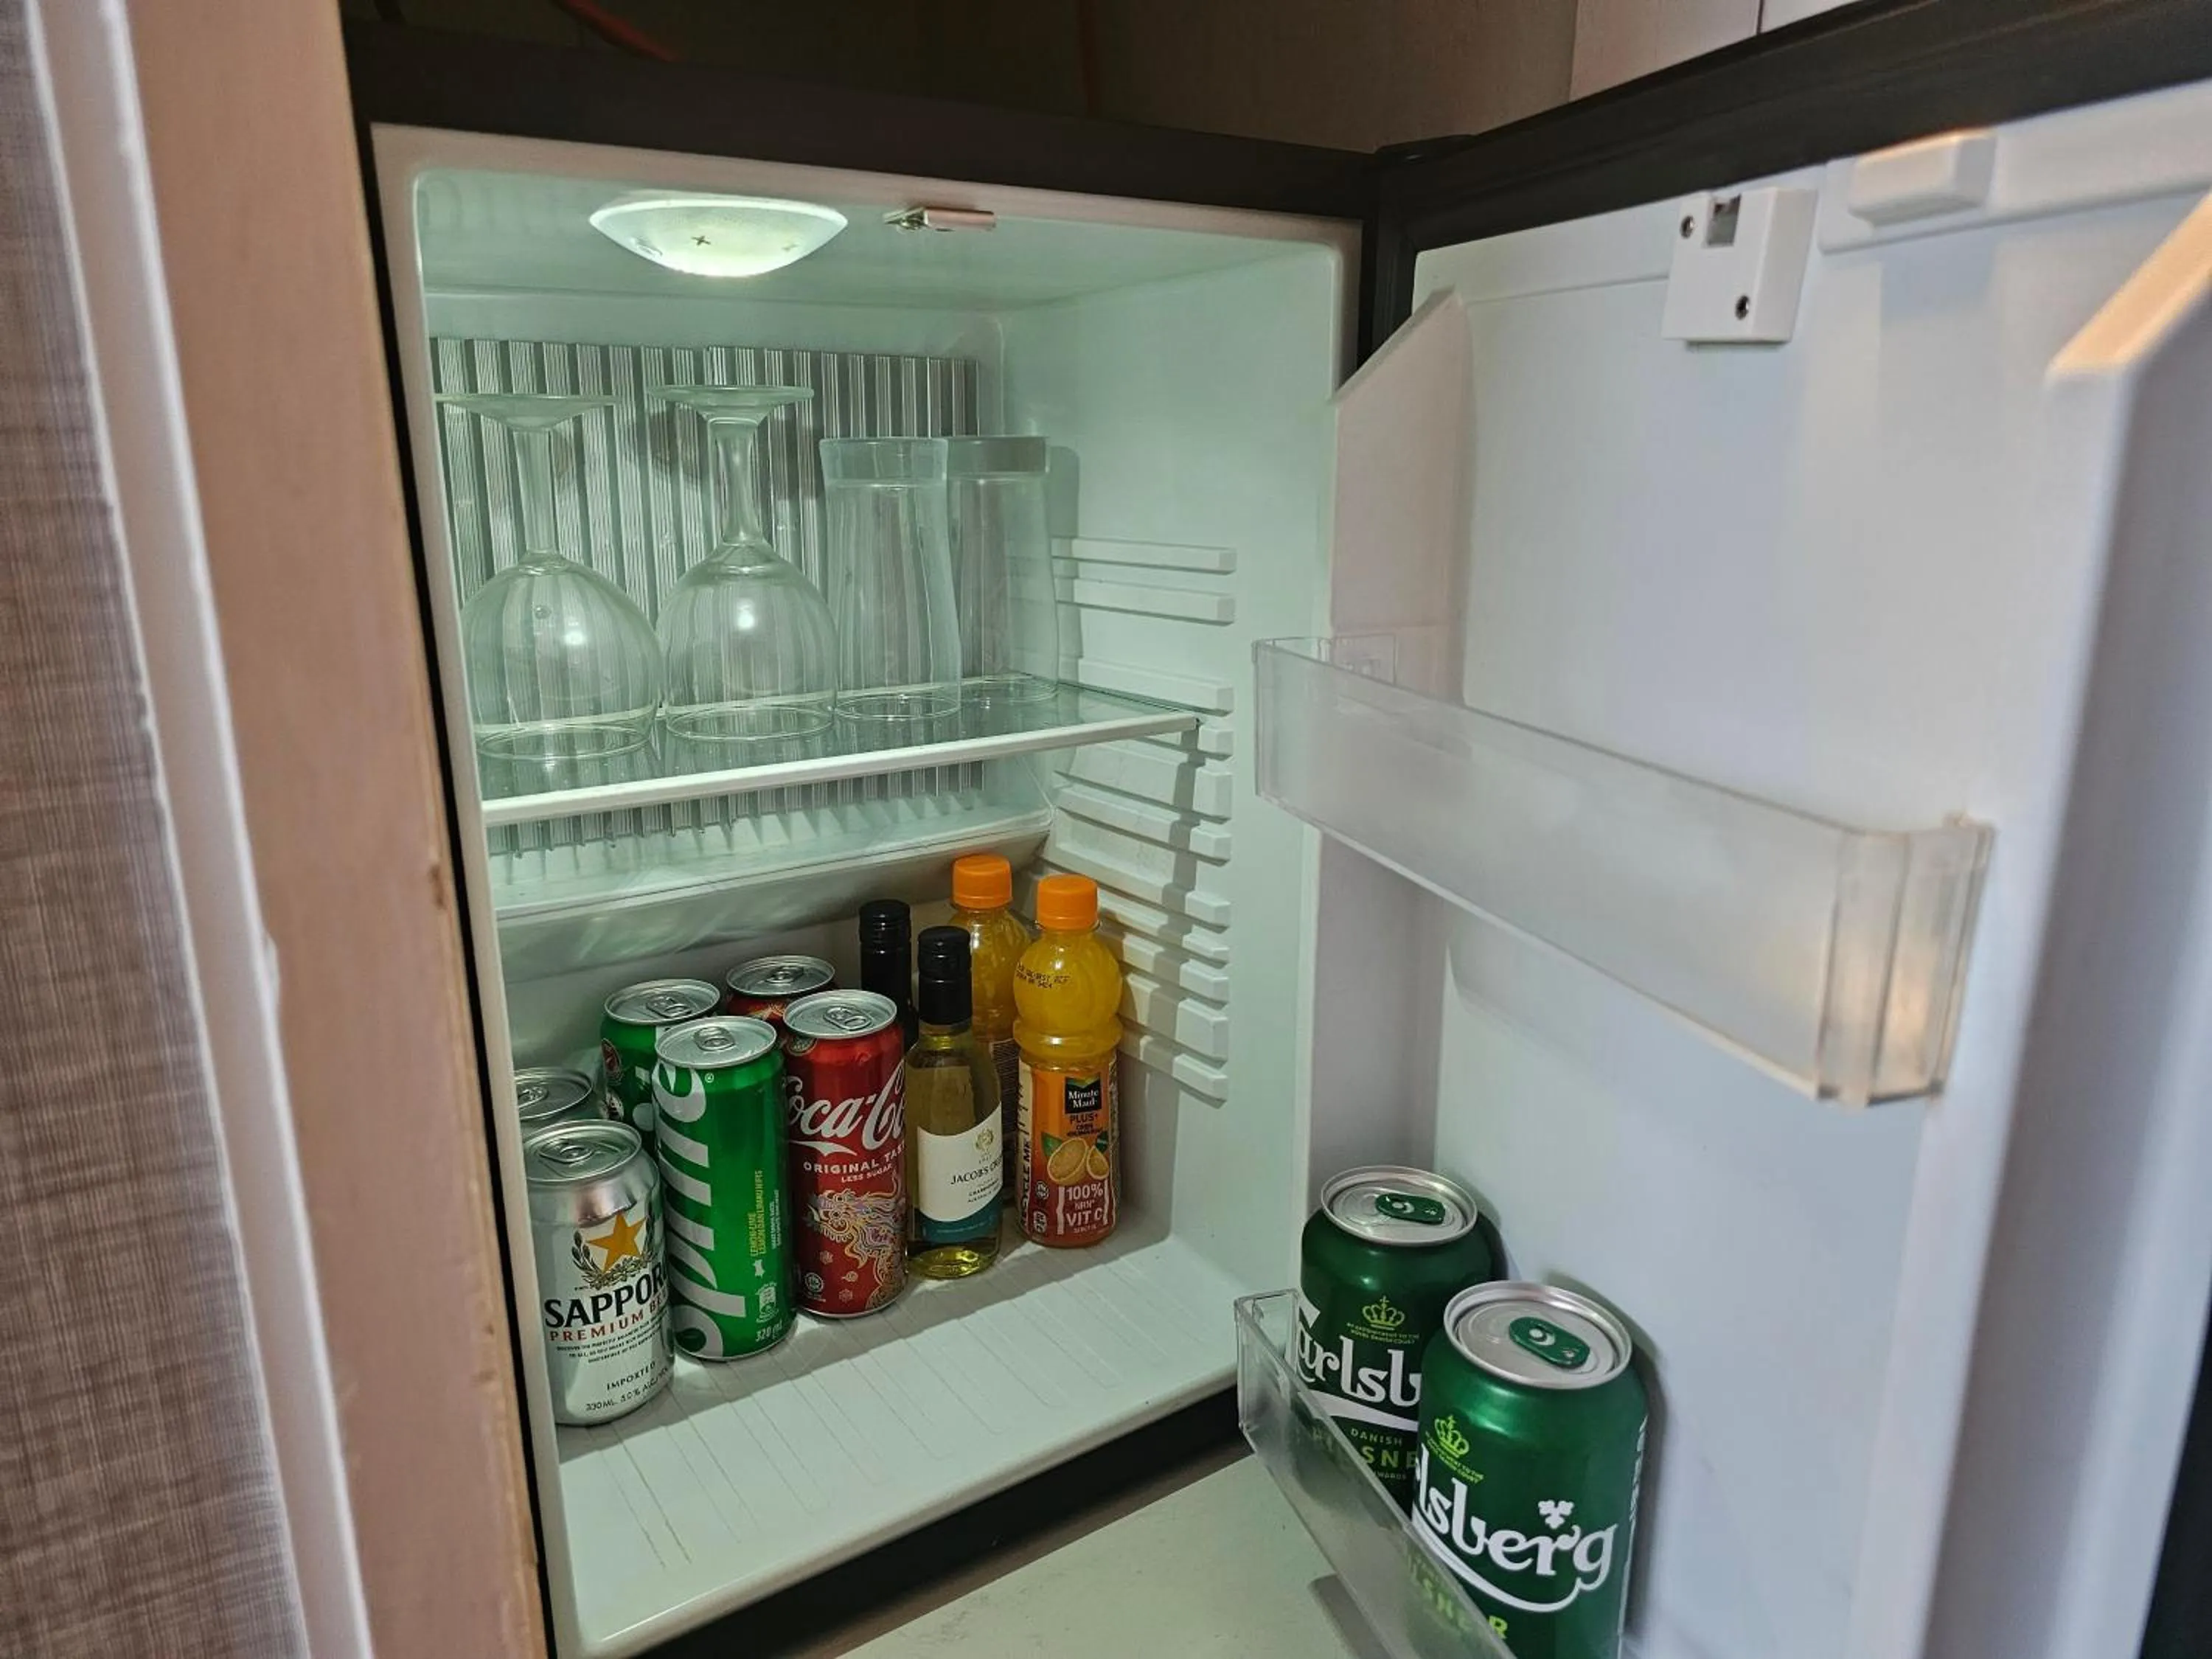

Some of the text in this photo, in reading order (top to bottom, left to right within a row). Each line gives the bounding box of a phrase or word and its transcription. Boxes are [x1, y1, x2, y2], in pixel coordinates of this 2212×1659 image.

[783, 1059, 905, 1150] oca-Co
[803, 1140, 905, 1175] ORIGINAL TAST
[841, 1163, 893, 1183] LESS SUGAR
[1066, 1182, 1103, 1200] 100%
[1066, 1207, 1103, 1226] VIT C
[544, 1262, 667, 1328] SAPPOR
[549, 1309, 644, 1341] PREMIUM
[650, 1292, 667, 1313] BE
[1296, 1292, 1422, 1407] arlsb
[607, 1360, 655, 1391] IMPORTED
[1350, 1427, 1402, 1447] DANISH
[1416, 1441, 1618, 1591] lsberg
